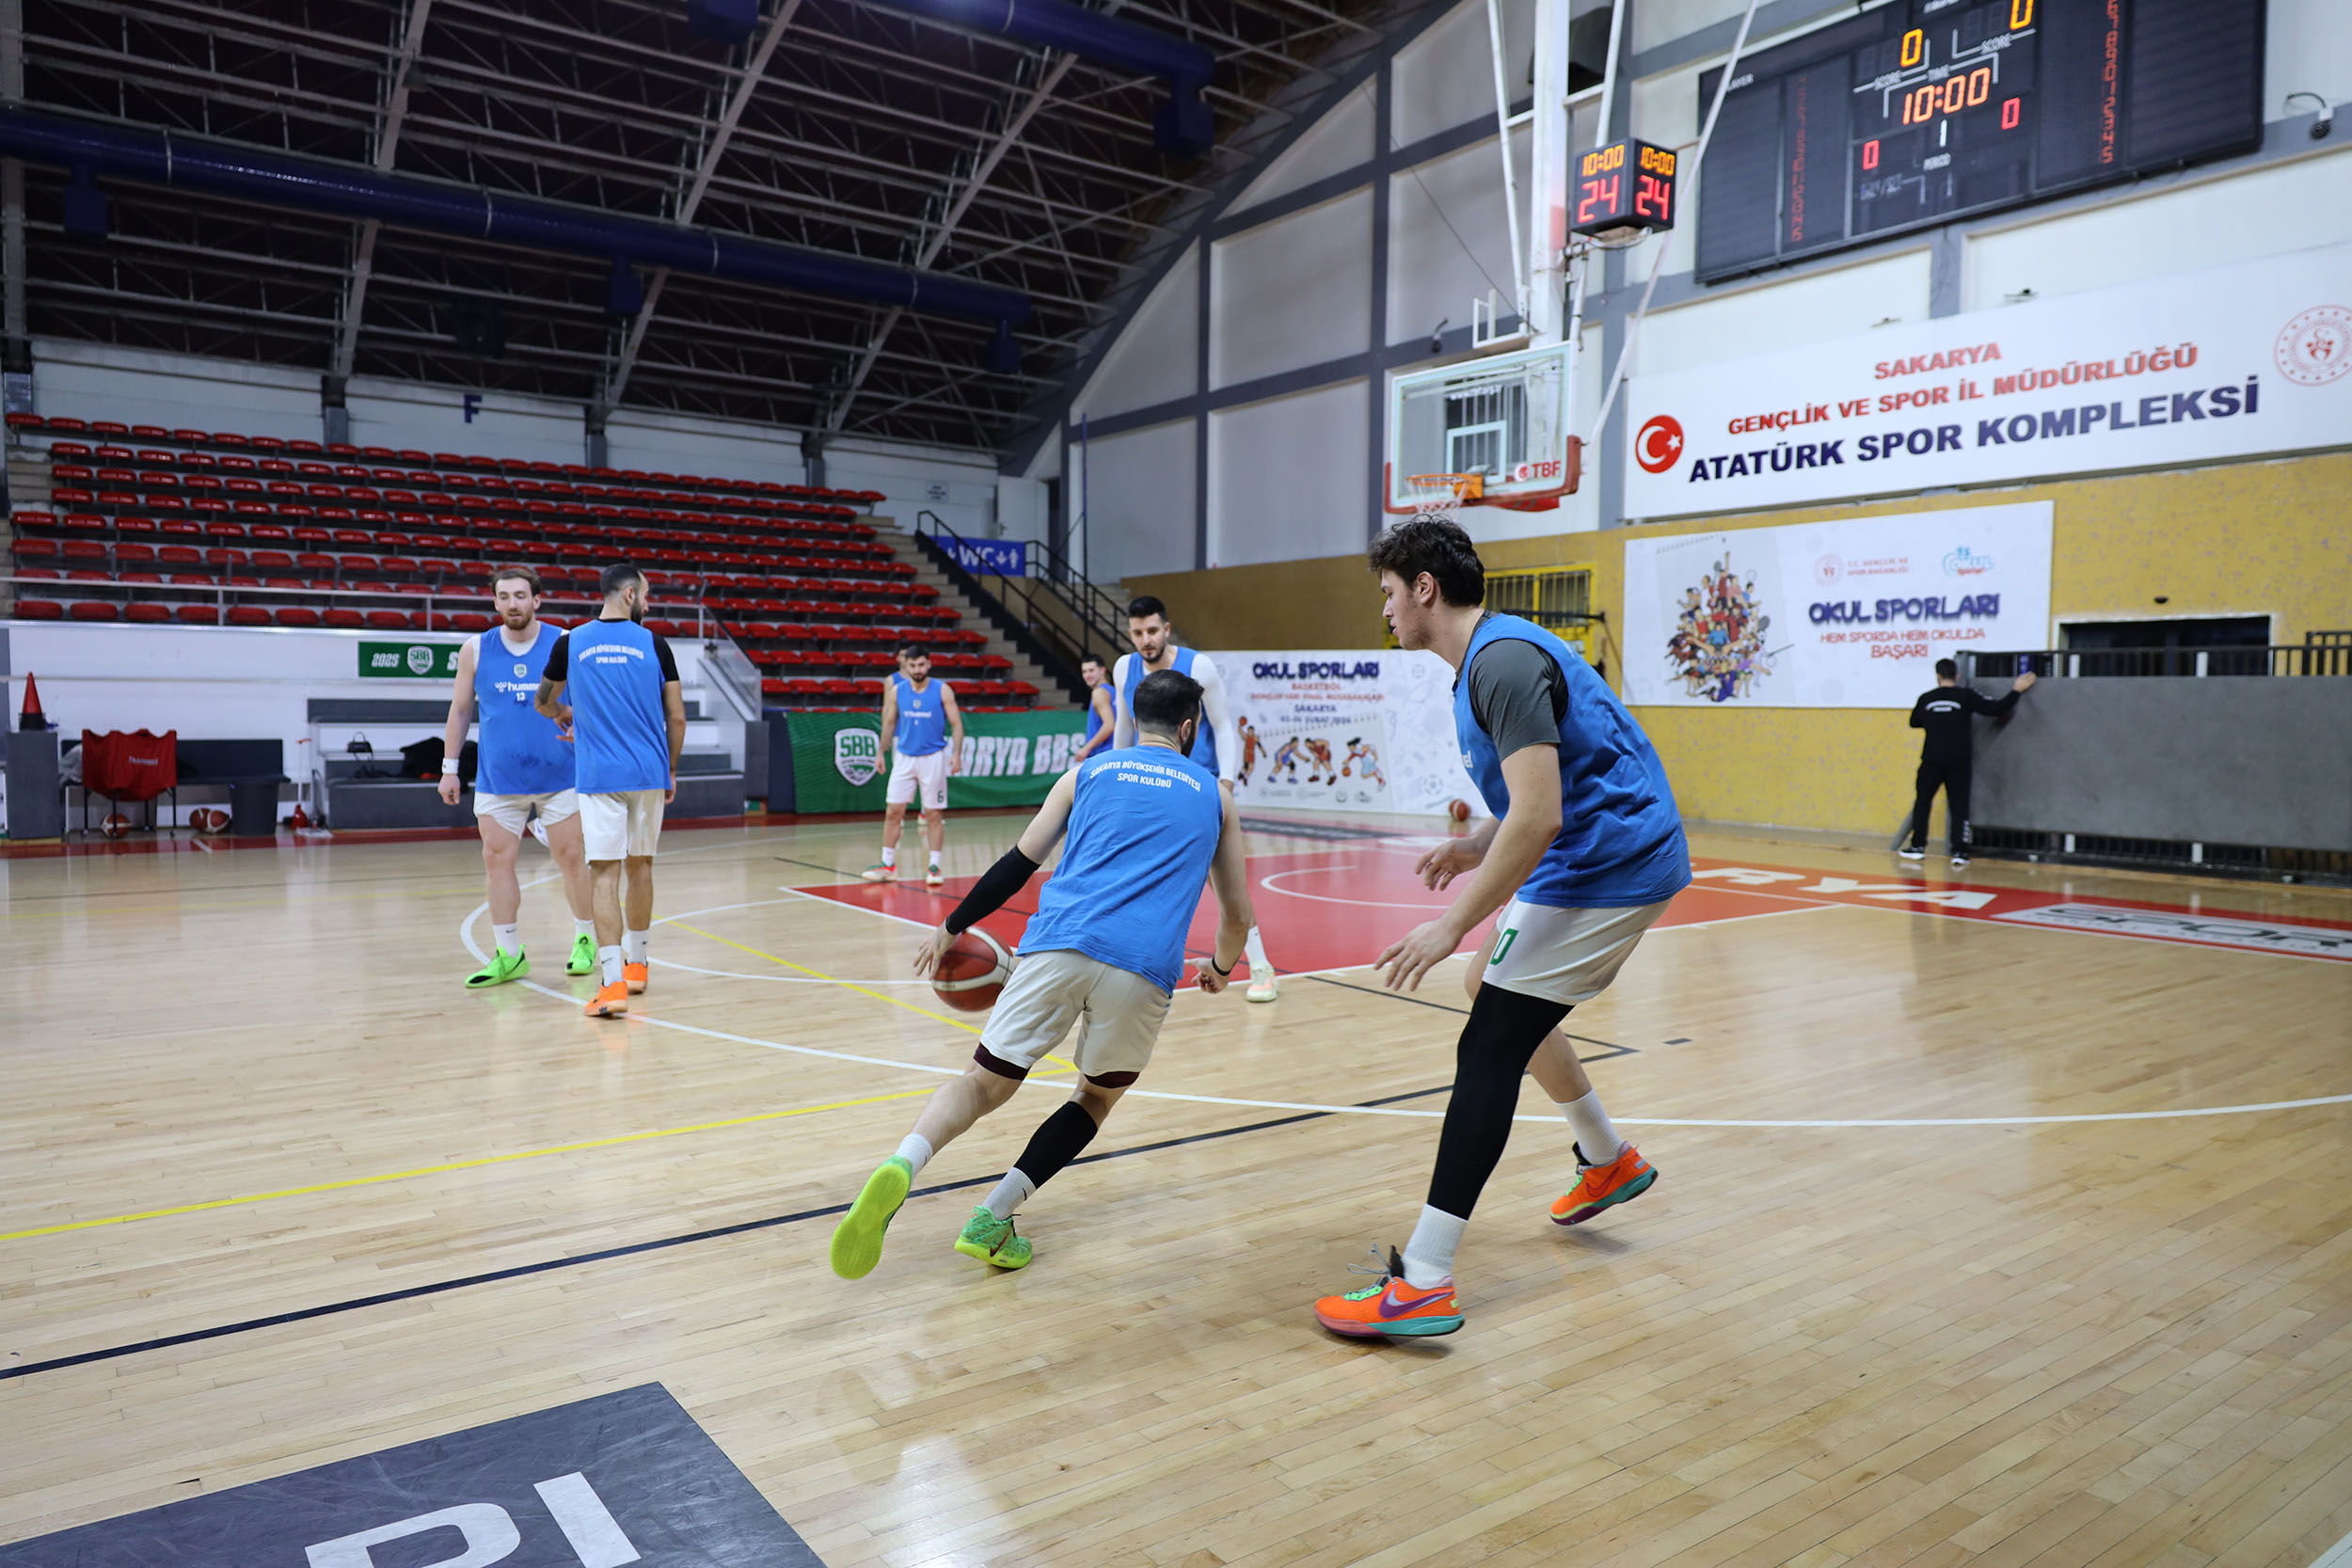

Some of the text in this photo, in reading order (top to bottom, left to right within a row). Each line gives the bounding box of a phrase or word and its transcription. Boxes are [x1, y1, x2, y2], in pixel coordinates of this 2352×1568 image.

[1900, 28, 1923, 67] 0
[1902, 68, 1991, 125] 10:00
[2002, 98, 2021, 130] 0
[1582, 145, 1625, 177] 10:00
[1641, 147, 1675, 177] 10:00
[1863, 140, 1880, 170] 0
[1579, 175, 1618, 223] 24
[1636, 175, 1671, 220] 24
[1874, 342, 2002, 380] SAKARYA
[1728, 341, 2199, 435] GENÇLİK VE SPOR İL MÜDÜRLÜĞÜ
[464, 394, 482, 423] F
[1690, 374, 2259, 483] ATATÜRK SPOR KOMPLEKSİ
[1532, 461, 1562, 479] TBF
[959, 546, 993, 566] WC
[1809, 594, 2000, 624] OKUL SPORLARI
[1820, 627, 1985, 643] HEM SPORDA HEM OKULDA
[1870, 645, 1929, 660] BAŞARI
[1253, 661, 1379, 679] OKUL SPORLARI
[516, 692, 526, 702] 13
[841, 736, 876, 757] SBB
[1089, 760, 1201, 792] SAKARYA BÜYÜKŞEHİR BELEDİYESİ
[1118, 773, 1172, 788] SPOR KULÜBÜ
